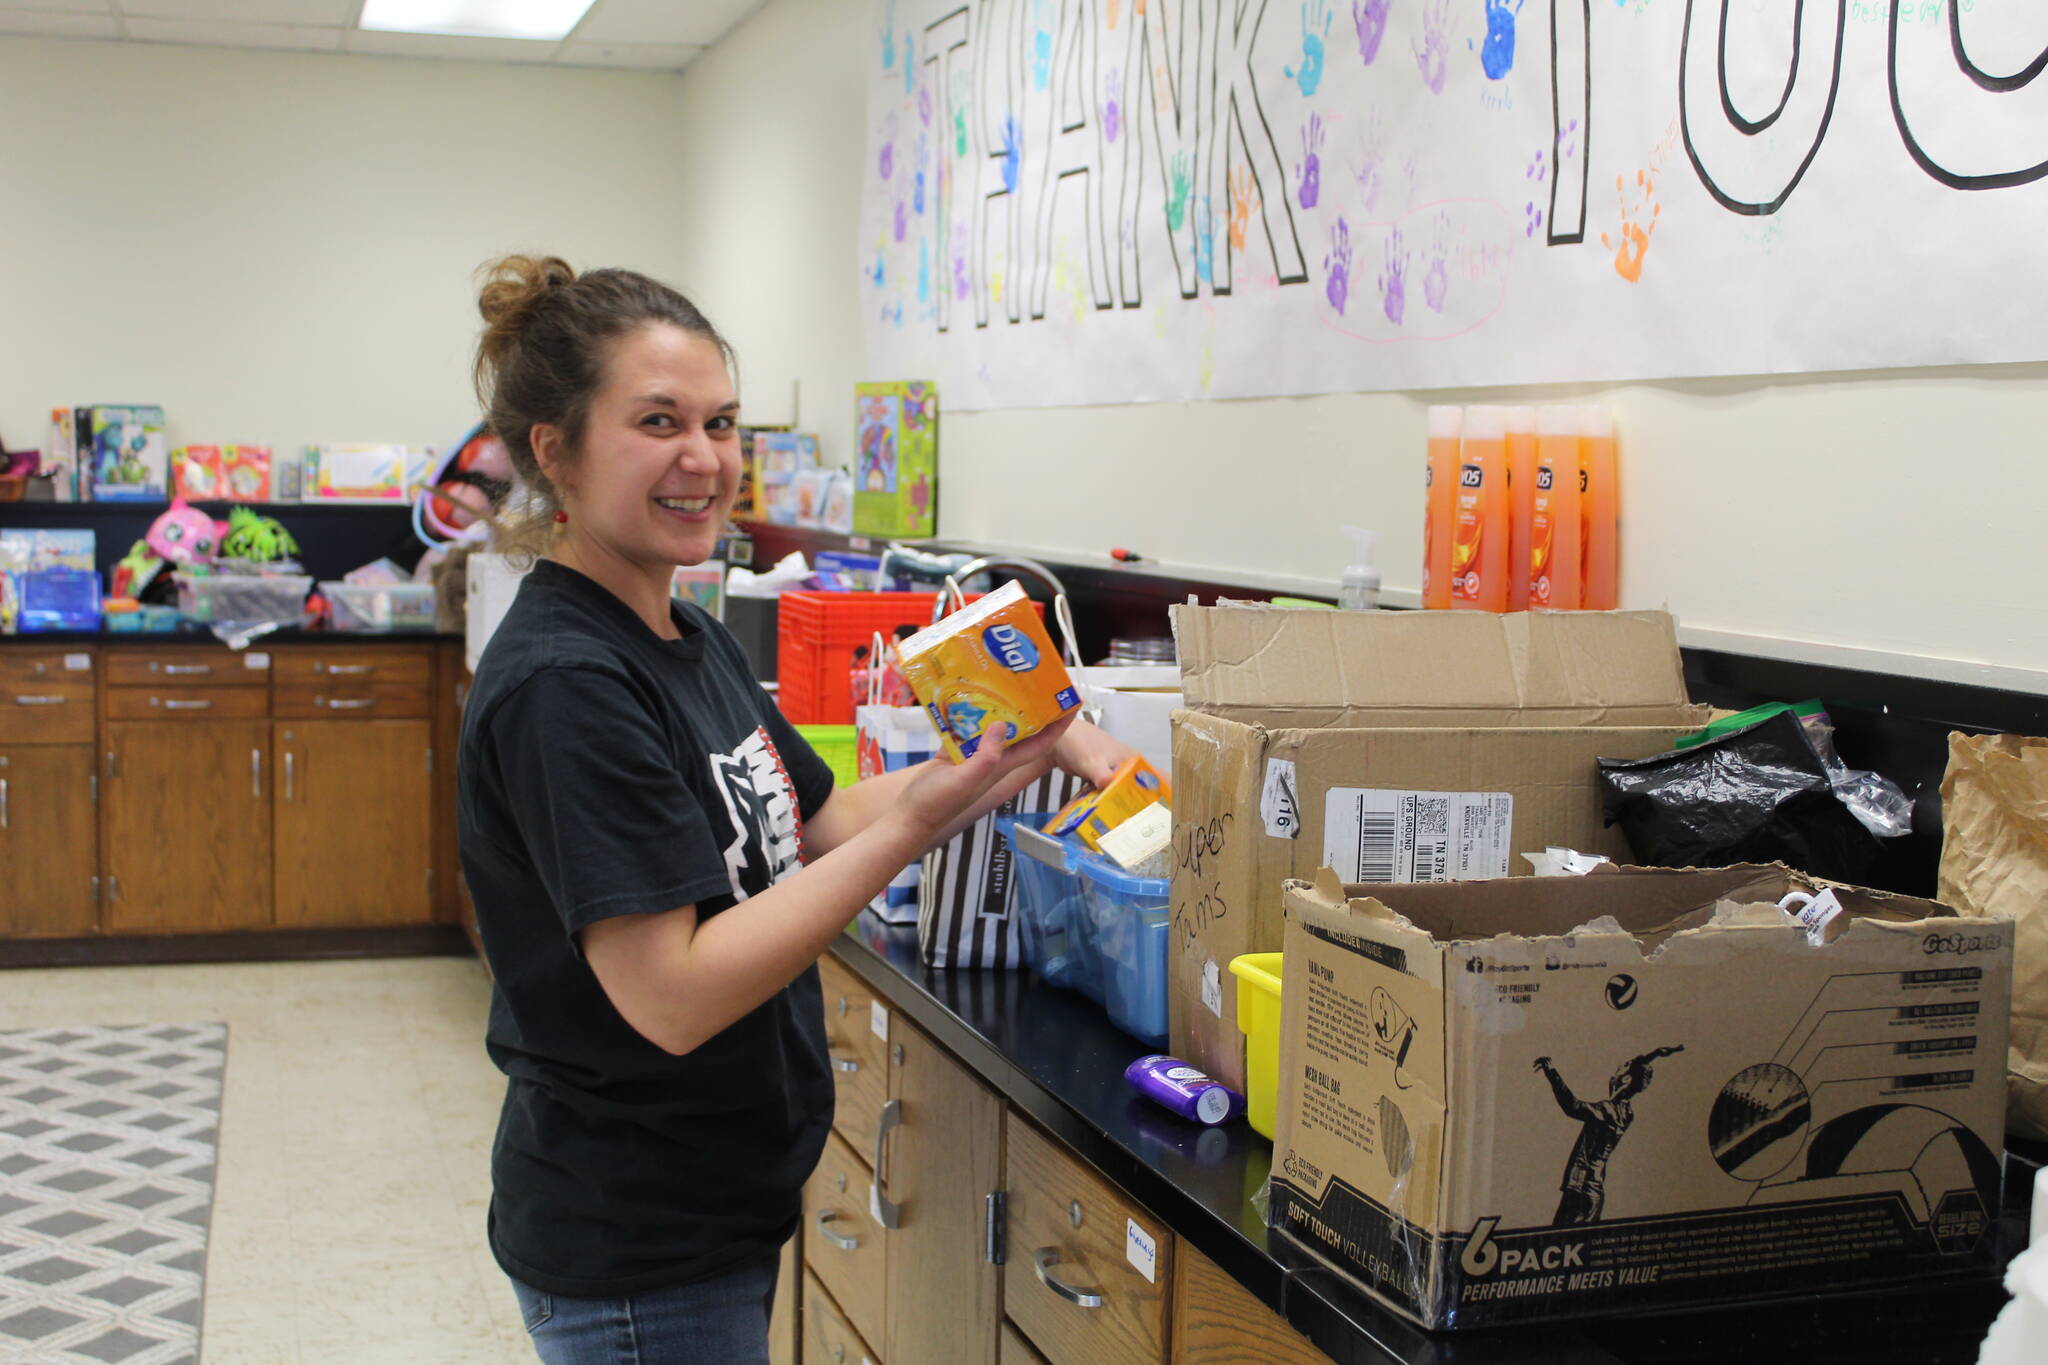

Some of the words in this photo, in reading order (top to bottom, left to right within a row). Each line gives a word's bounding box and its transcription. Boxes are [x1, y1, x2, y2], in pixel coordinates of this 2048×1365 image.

[922, 0, 1308, 333] THANK
[990, 623, 1033, 672] Dial
[1406, 796, 1414, 814] UPS
[1463, 805, 1471, 839] KNOXVILLE
[1171, 812, 1234, 884] Super
[1404, 815, 1413, 851] GROUND
[1436, 840, 1446, 853] TN
[993, 834, 1009, 894] stuhlber
[1434, 856, 1445, 875] 379
[1922, 932, 2000, 955] GoSports
[1509, 983, 1541, 993] FRIENDLY
[1318, 1069, 1330, 1091] BALL
[1330, 1077, 1341, 1095] BAG
[1287, 1200, 1311, 1229] SOFT
[1311, 1214, 1341, 1250] TOUCH
[1459, 1214, 1502, 1277] 6
[1499, 1243, 1585, 1275] PACK
[1461, 1275, 1565, 1303] PERFORMANCE
[1567, 1269, 1614, 1291] MEETS
[1617, 1264, 1661, 1286] VALUE
